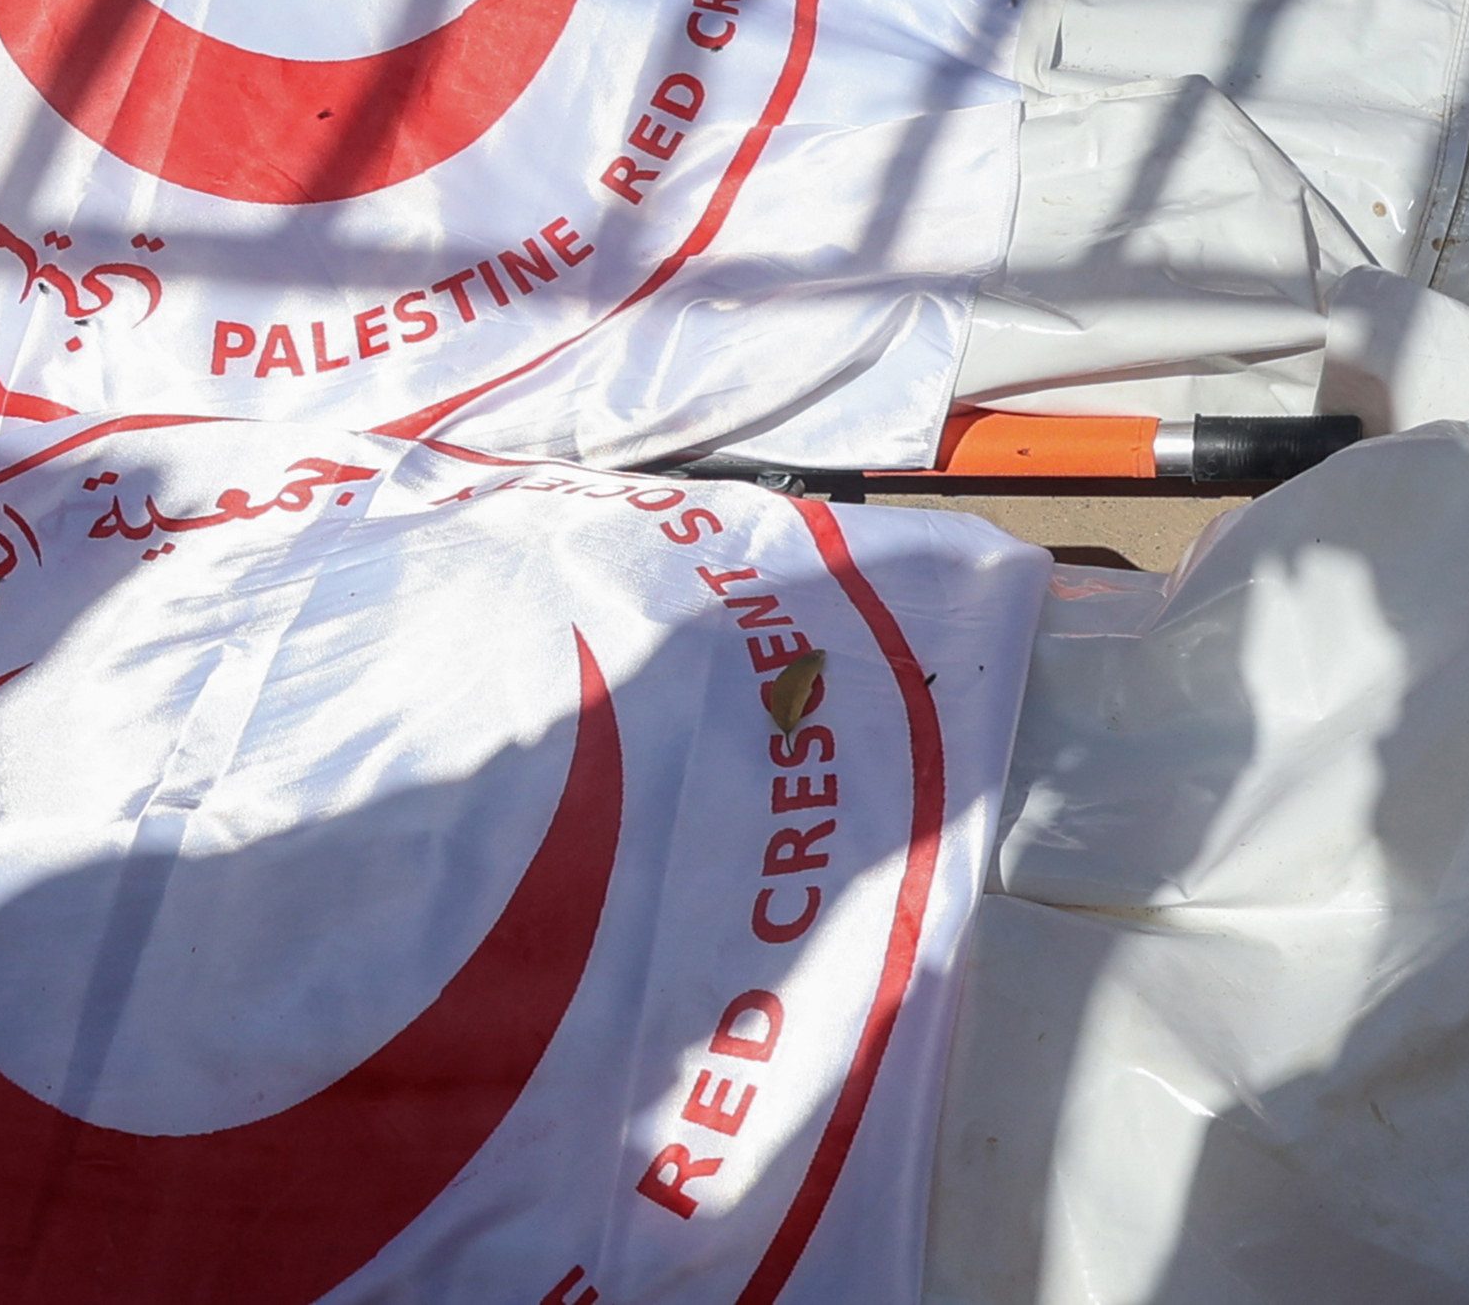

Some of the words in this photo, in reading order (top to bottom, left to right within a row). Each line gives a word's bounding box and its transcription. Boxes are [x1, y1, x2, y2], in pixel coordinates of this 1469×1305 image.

[209, 215, 596, 381] PALESTINE
[601, 70, 708, 207] RED
[82, 456, 382, 561] جمعية
[636, 987, 786, 1222] RED
